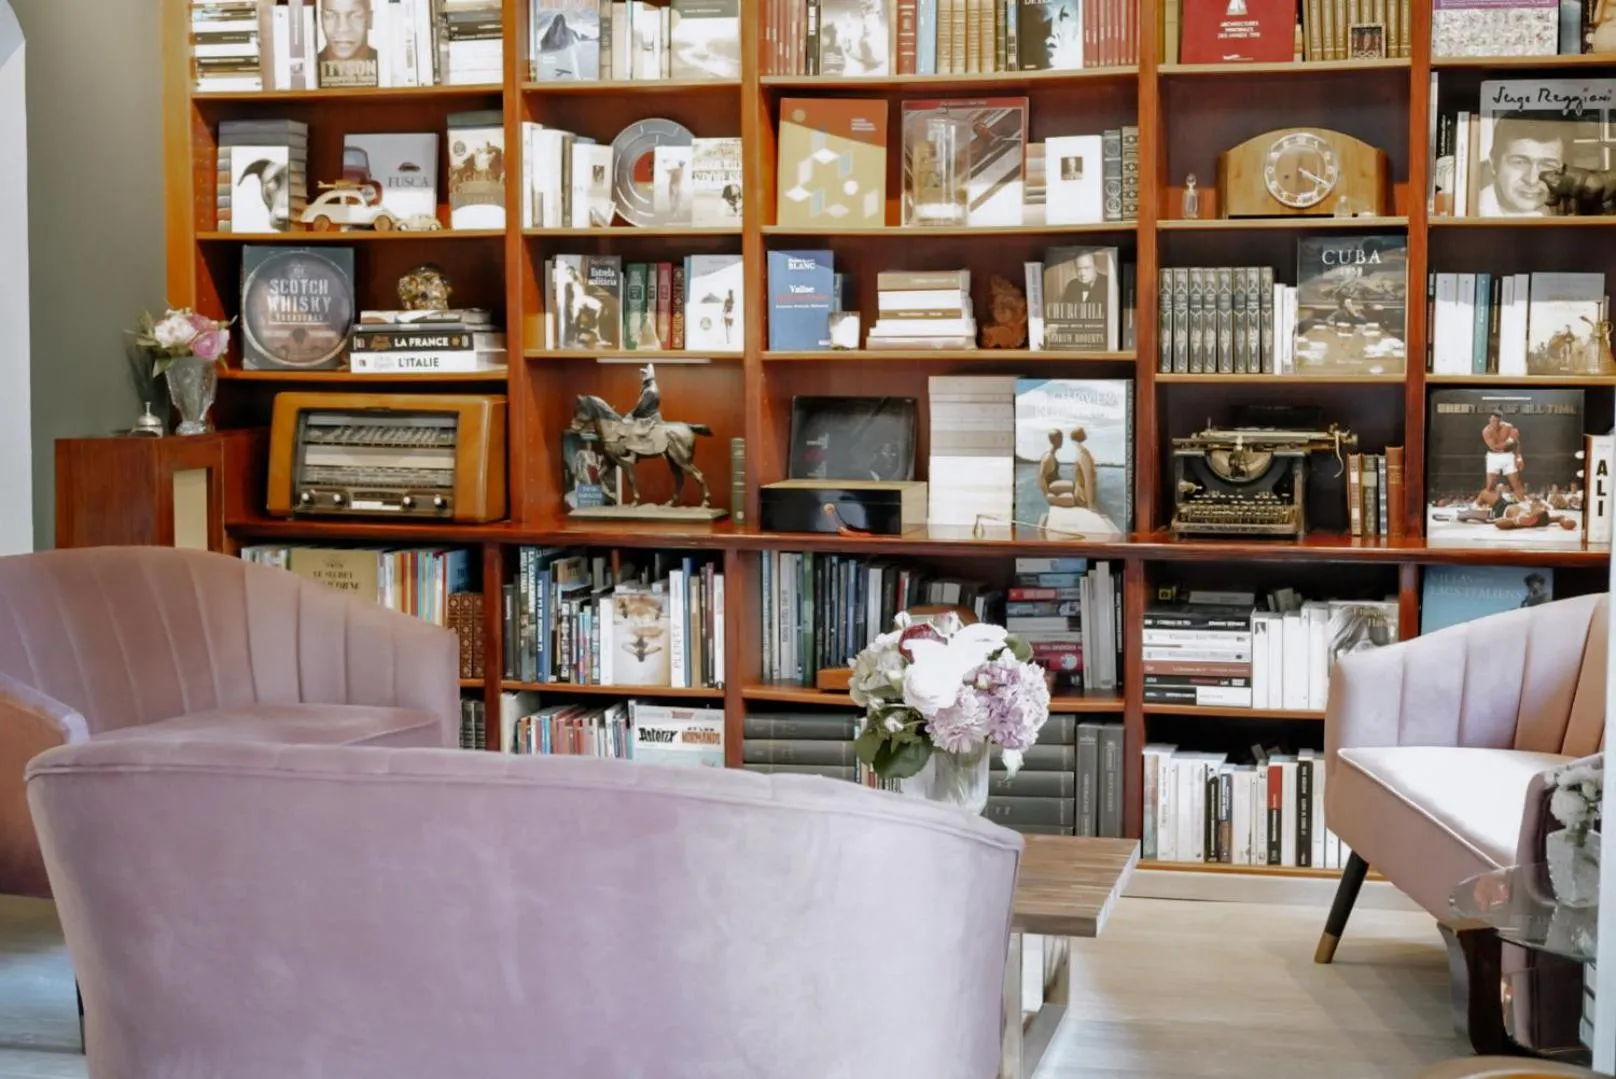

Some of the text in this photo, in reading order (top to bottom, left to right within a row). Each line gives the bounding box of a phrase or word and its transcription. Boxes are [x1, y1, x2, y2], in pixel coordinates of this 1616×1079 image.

[1321, 249, 1382, 265] CUBA
[269, 279, 330, 295] SCOTCH
[266, 295, 332, 313] WHISKY
[394, 336, 449, 348] LA FRANCE
[397, 357, 440, 368] L'ITALIE
[1595, 458, 1609, 518] ALI
